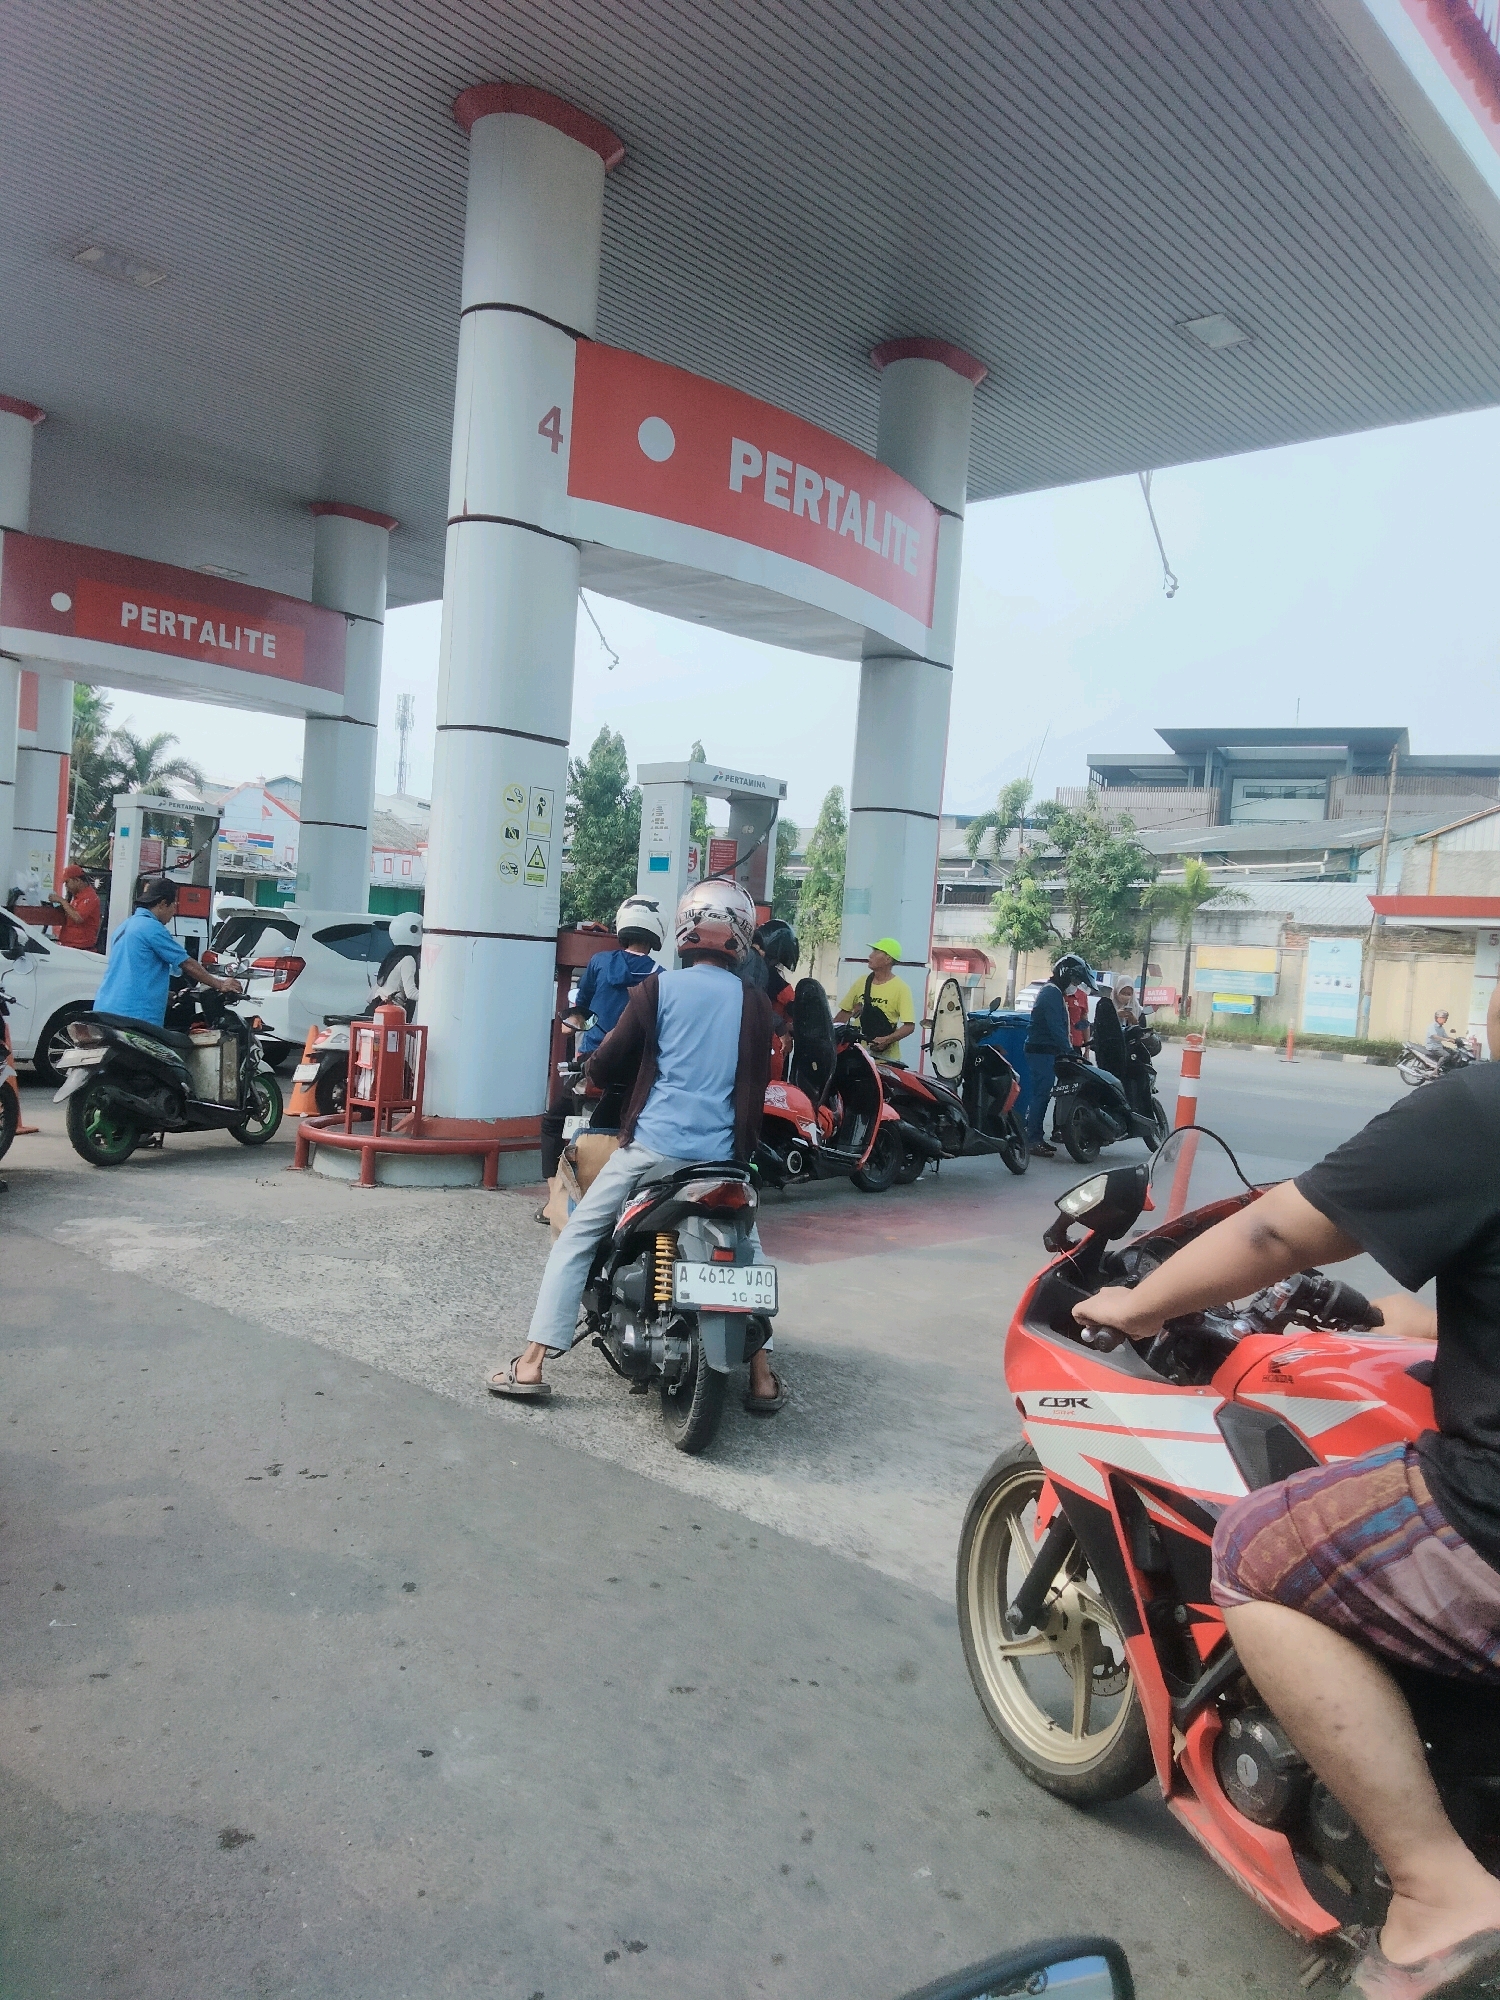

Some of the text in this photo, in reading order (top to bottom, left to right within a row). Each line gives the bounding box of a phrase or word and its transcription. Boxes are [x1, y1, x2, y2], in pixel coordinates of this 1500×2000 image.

[538, 405, 564, 455] 4
[728, 436, 920, 577] PERTALITE
[120, 601, 276, 659] PERTALITE
[724, 774, 767, 789] PERTAMINA
[168, 801, 205, 812] PERTAMINA
[1488, 933, 1500, 947] 5
[567, 1118, 573, 1128] B
[680, 1265, 773, 1288] A 4612 VAO
[1038, 1396, 1094, 1410] CBR
